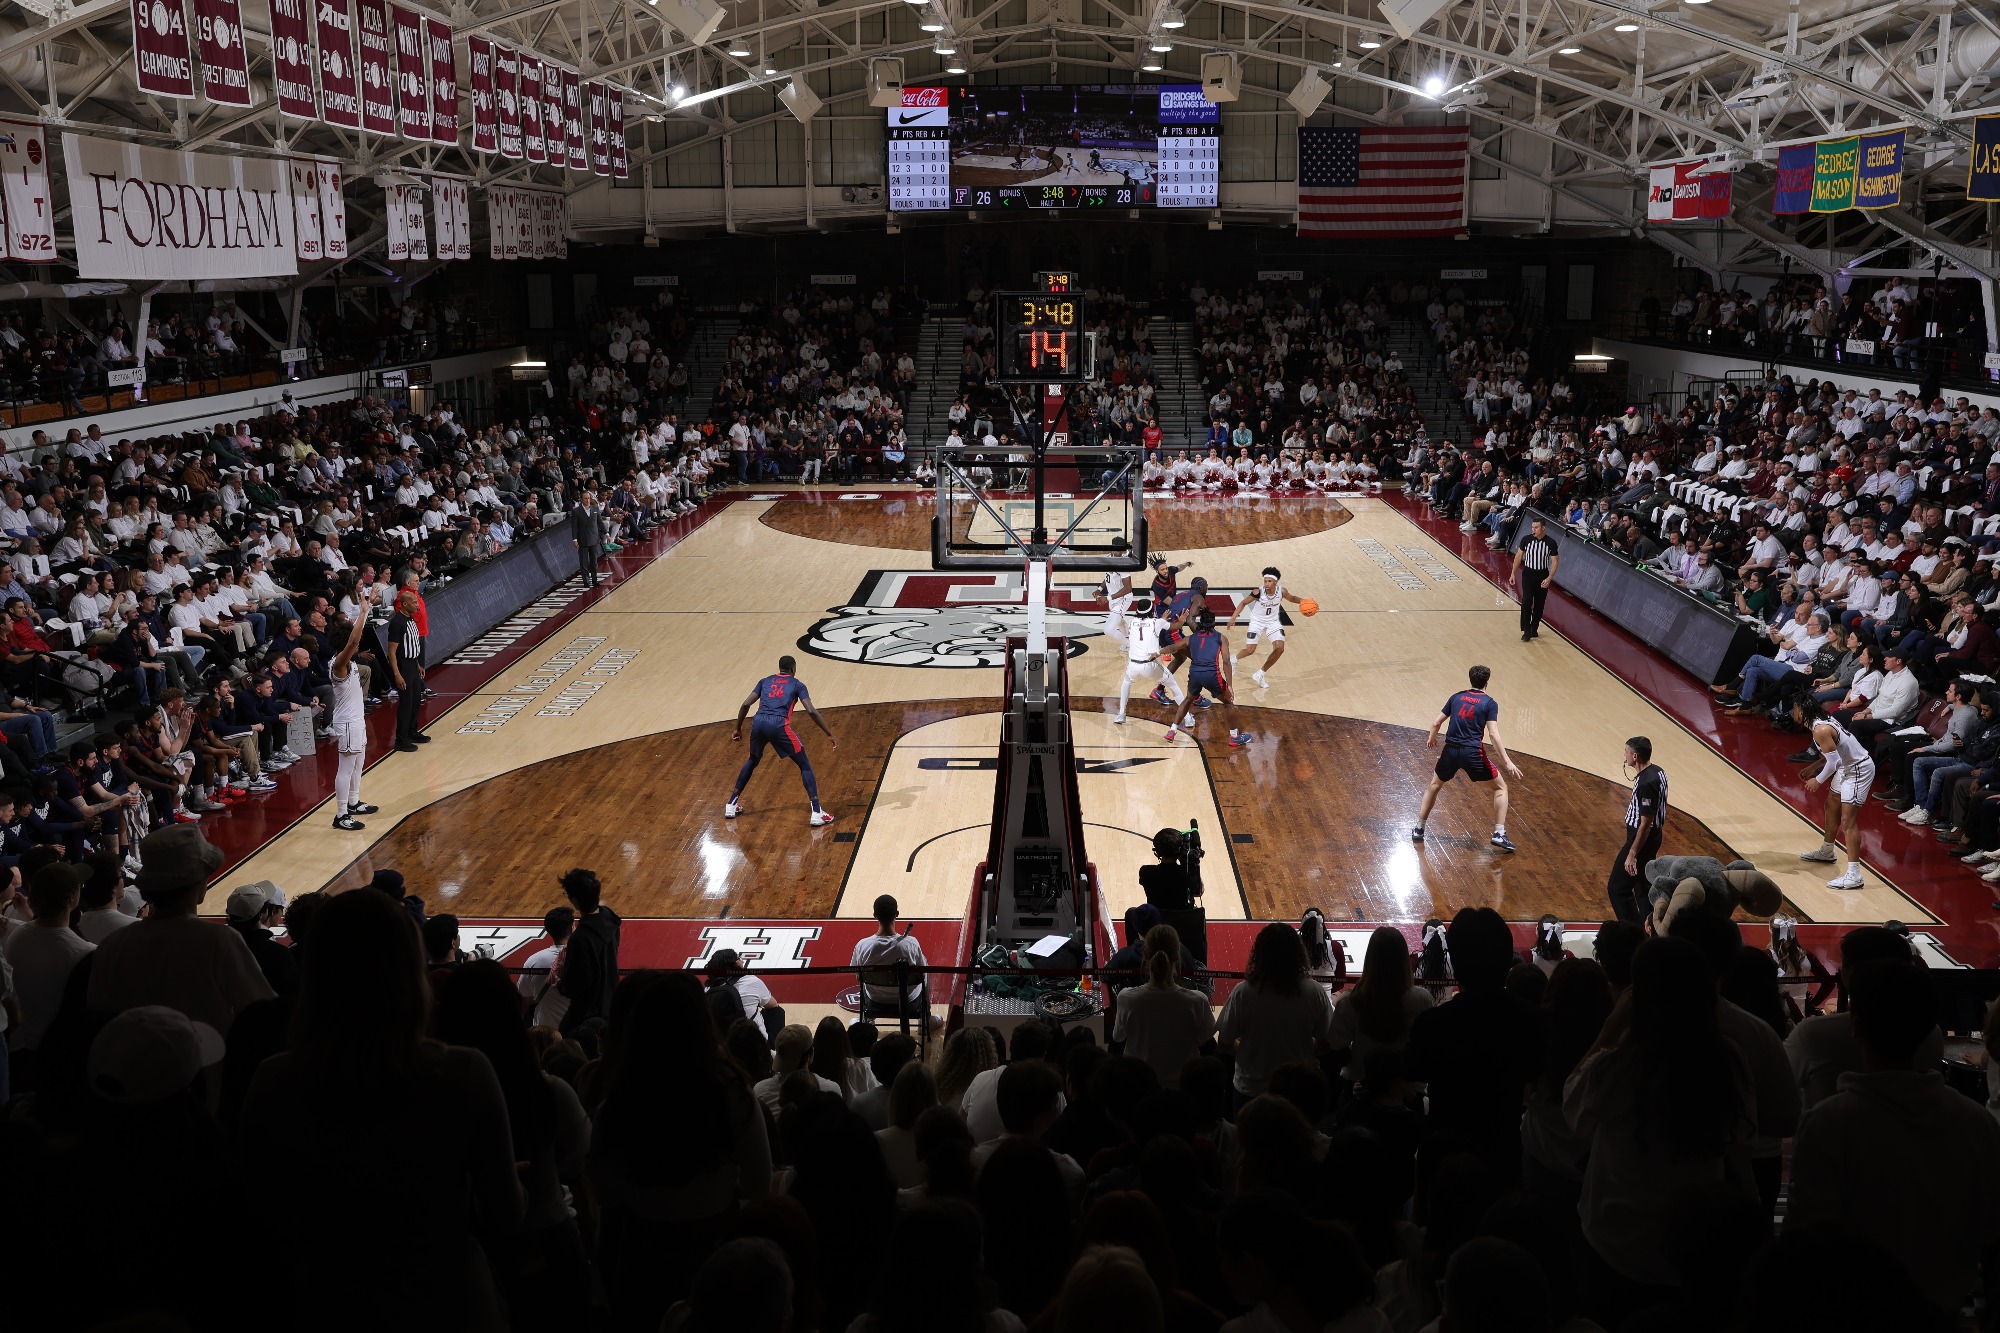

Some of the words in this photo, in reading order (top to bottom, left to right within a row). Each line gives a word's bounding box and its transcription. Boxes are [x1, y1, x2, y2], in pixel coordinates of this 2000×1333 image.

[1161, 110, 1186, 119] multiply
[1201, 110, 1216, 119] good
[893, 130, 898, 138] #
[902, 130, 913, 138] PTS
[916, 130, 928, 138] REB
[932, 130, 936, 138] A
[940, 130, 944, 138] F
[1162, 127, 1168, 136] #
[1172, 127, 1182, 136] PTS
[1186, 127, 1198, 136] REB
[1202, 127, 1206, 136] A
[1211, 127, 1214, 136] F
[894, 142, 898, 150] 0
[1175, 139, 1179, 147] 2
[1190, 139, 1194, 147] 0
[1202, 139, 1206, 147] 0
[1210, 139, 1214, 147] 0
[906, 153, 910, 161] 5
[932, 153, 936, 161] 0
[1163, 150, 1166, 158] 3
[1175, 150, 1179, 158] 5
[1189, 150, 1193, 158] 4
[1867, 143, 1897, 168] GEORGE
[892, 164, 900, 172] 12
[906, 164, 910, 172] 3
[932, 164, 936, 172] 0
[941, 164, 945, 172] 0
[1817, 149, 1855, 175] GEORGE
[1043, 186, 1064, 199] 3:48
[1649, 185, 1672, 203] A10
[1674, 181, 1700, 199] DAVIDSON
[1815, 177, 1850, 200] MASON
[976, 191, 991, 204] 26
[1117, 190, 1131, 203] 28
[89, 170, 283, 249] FORDHAM
[16, 232, 52, 251] 1972
[1048, 274, 1068, 285] 3:48
[1023, 302, 1074, 325] 3:48
[1031, 330, 1066, 369] 14
[132, 370, 142, 381] 113
[1139, 626, 1144, 641] 1
[1200, 638, 1206, 648] 1
[455, 695, 537, 735] FRANK
[508, 635, 608, 693] McLAUGHLIN
[534, 680, 607, 717] FAMILY
[582, 648, 642, 678] COURT
[768, 684, 784, 698] 34
[1458, 704, 1475, 720] 44
[1016, 746, 1055, 755] SPALDING
